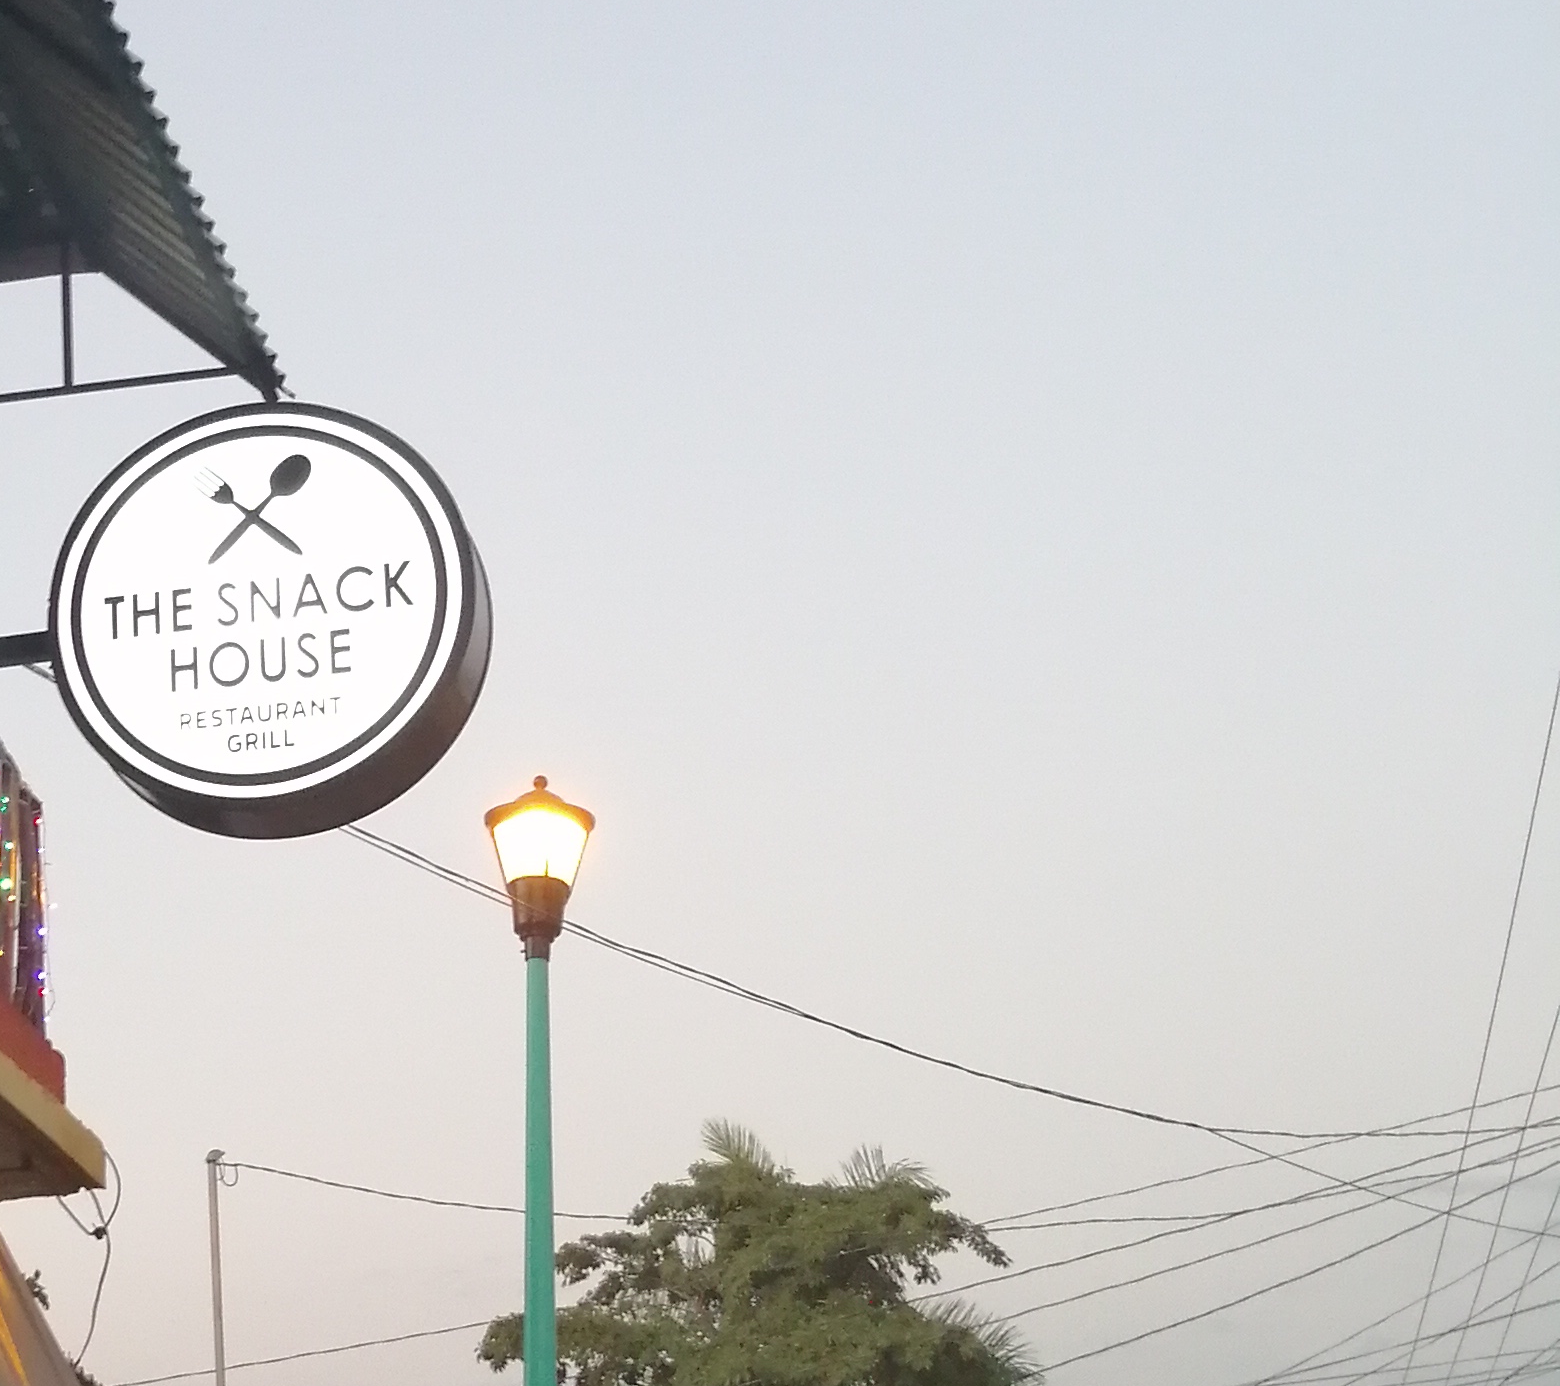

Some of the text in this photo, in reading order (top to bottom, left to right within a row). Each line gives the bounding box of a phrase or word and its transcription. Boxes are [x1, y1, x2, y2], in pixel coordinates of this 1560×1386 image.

[104, 560, 414, 640] THE SNACK
[170, 628, 352, 693] HOUSE
[180, 696, 342, 730] RESTAURANT
[227, 729, 295, 753] GRILL
